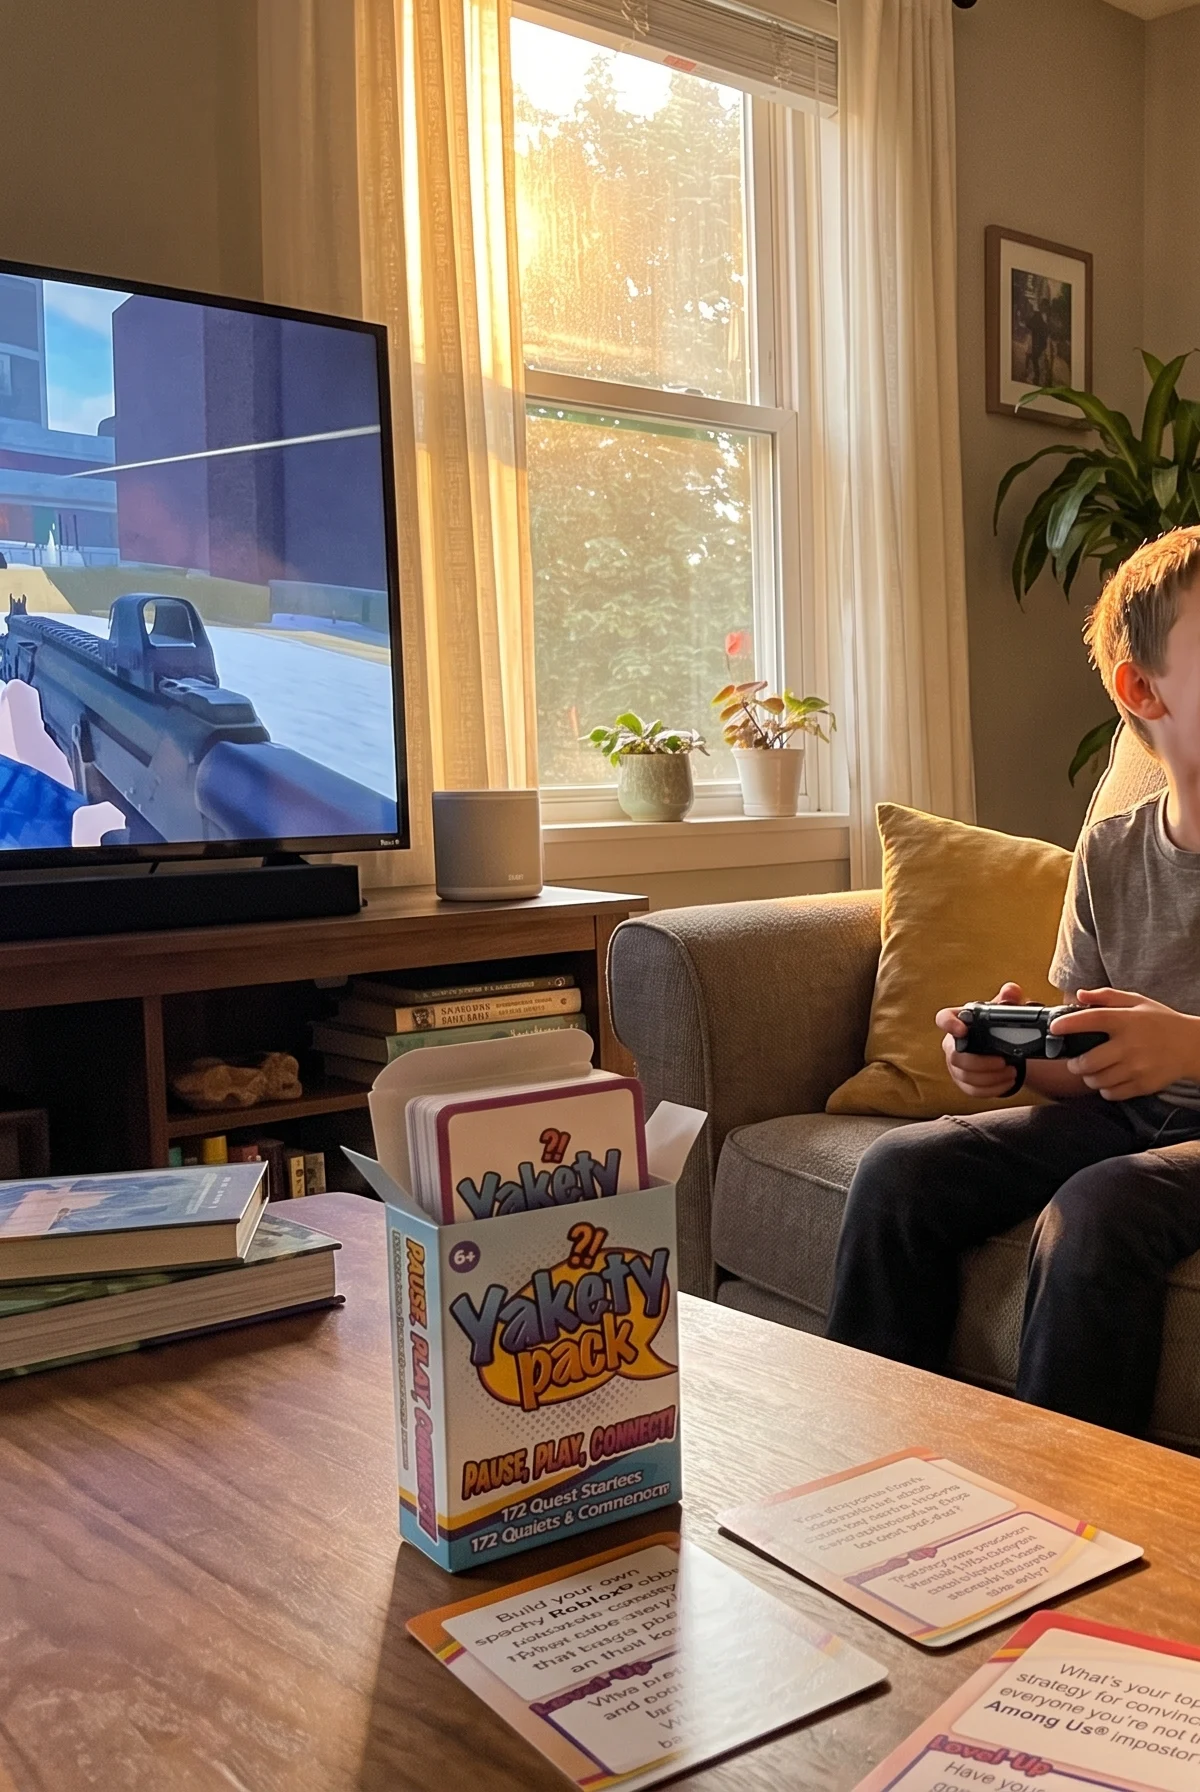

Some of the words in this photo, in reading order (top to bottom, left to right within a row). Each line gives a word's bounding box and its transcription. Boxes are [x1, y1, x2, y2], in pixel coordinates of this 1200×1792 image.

[456, 1148, 622, 1219] Yakety
[452, 1250, 476, 1266] 6+
[450, 1247, 671, 1367] Yakety
[514, 1312, 639, 1412] pack
[461, 1448, 530, 1501] PAUSE,
[533, 1432, 587, 1481] PLAY,
[590, 1404, 676, 1462] CONNECT!
[501, 1503, 527, 1524] 172
[529, 1487, 579, 1515] Quest
[470, 1532, 498, 1553] 172
[564, 1509, 575, 1524] &
[495, 1600, 547, 1623] Build
[550, 1584, 593, 1604] your
[600, 1568, 640, 1587] own
[1016, 1672, 1092, 1699] strategy
[1095, 1691, 1123, 1706] for
[1059, 1663, 1122, 1688] What's
[1124, 1682, 1171, 1701] your
[603, 1701, 640, 1721] and
[984, 1700, 1060, 1729] Among
[1066, 1718, 1110, 1736] Us®
[999, 1687, 1085, 1714] everyone
[1088, 1709, 1148, 1731] you're
[1152, 1724, 1186, 1741] not
[944, 1761, 996, 1784] Have
